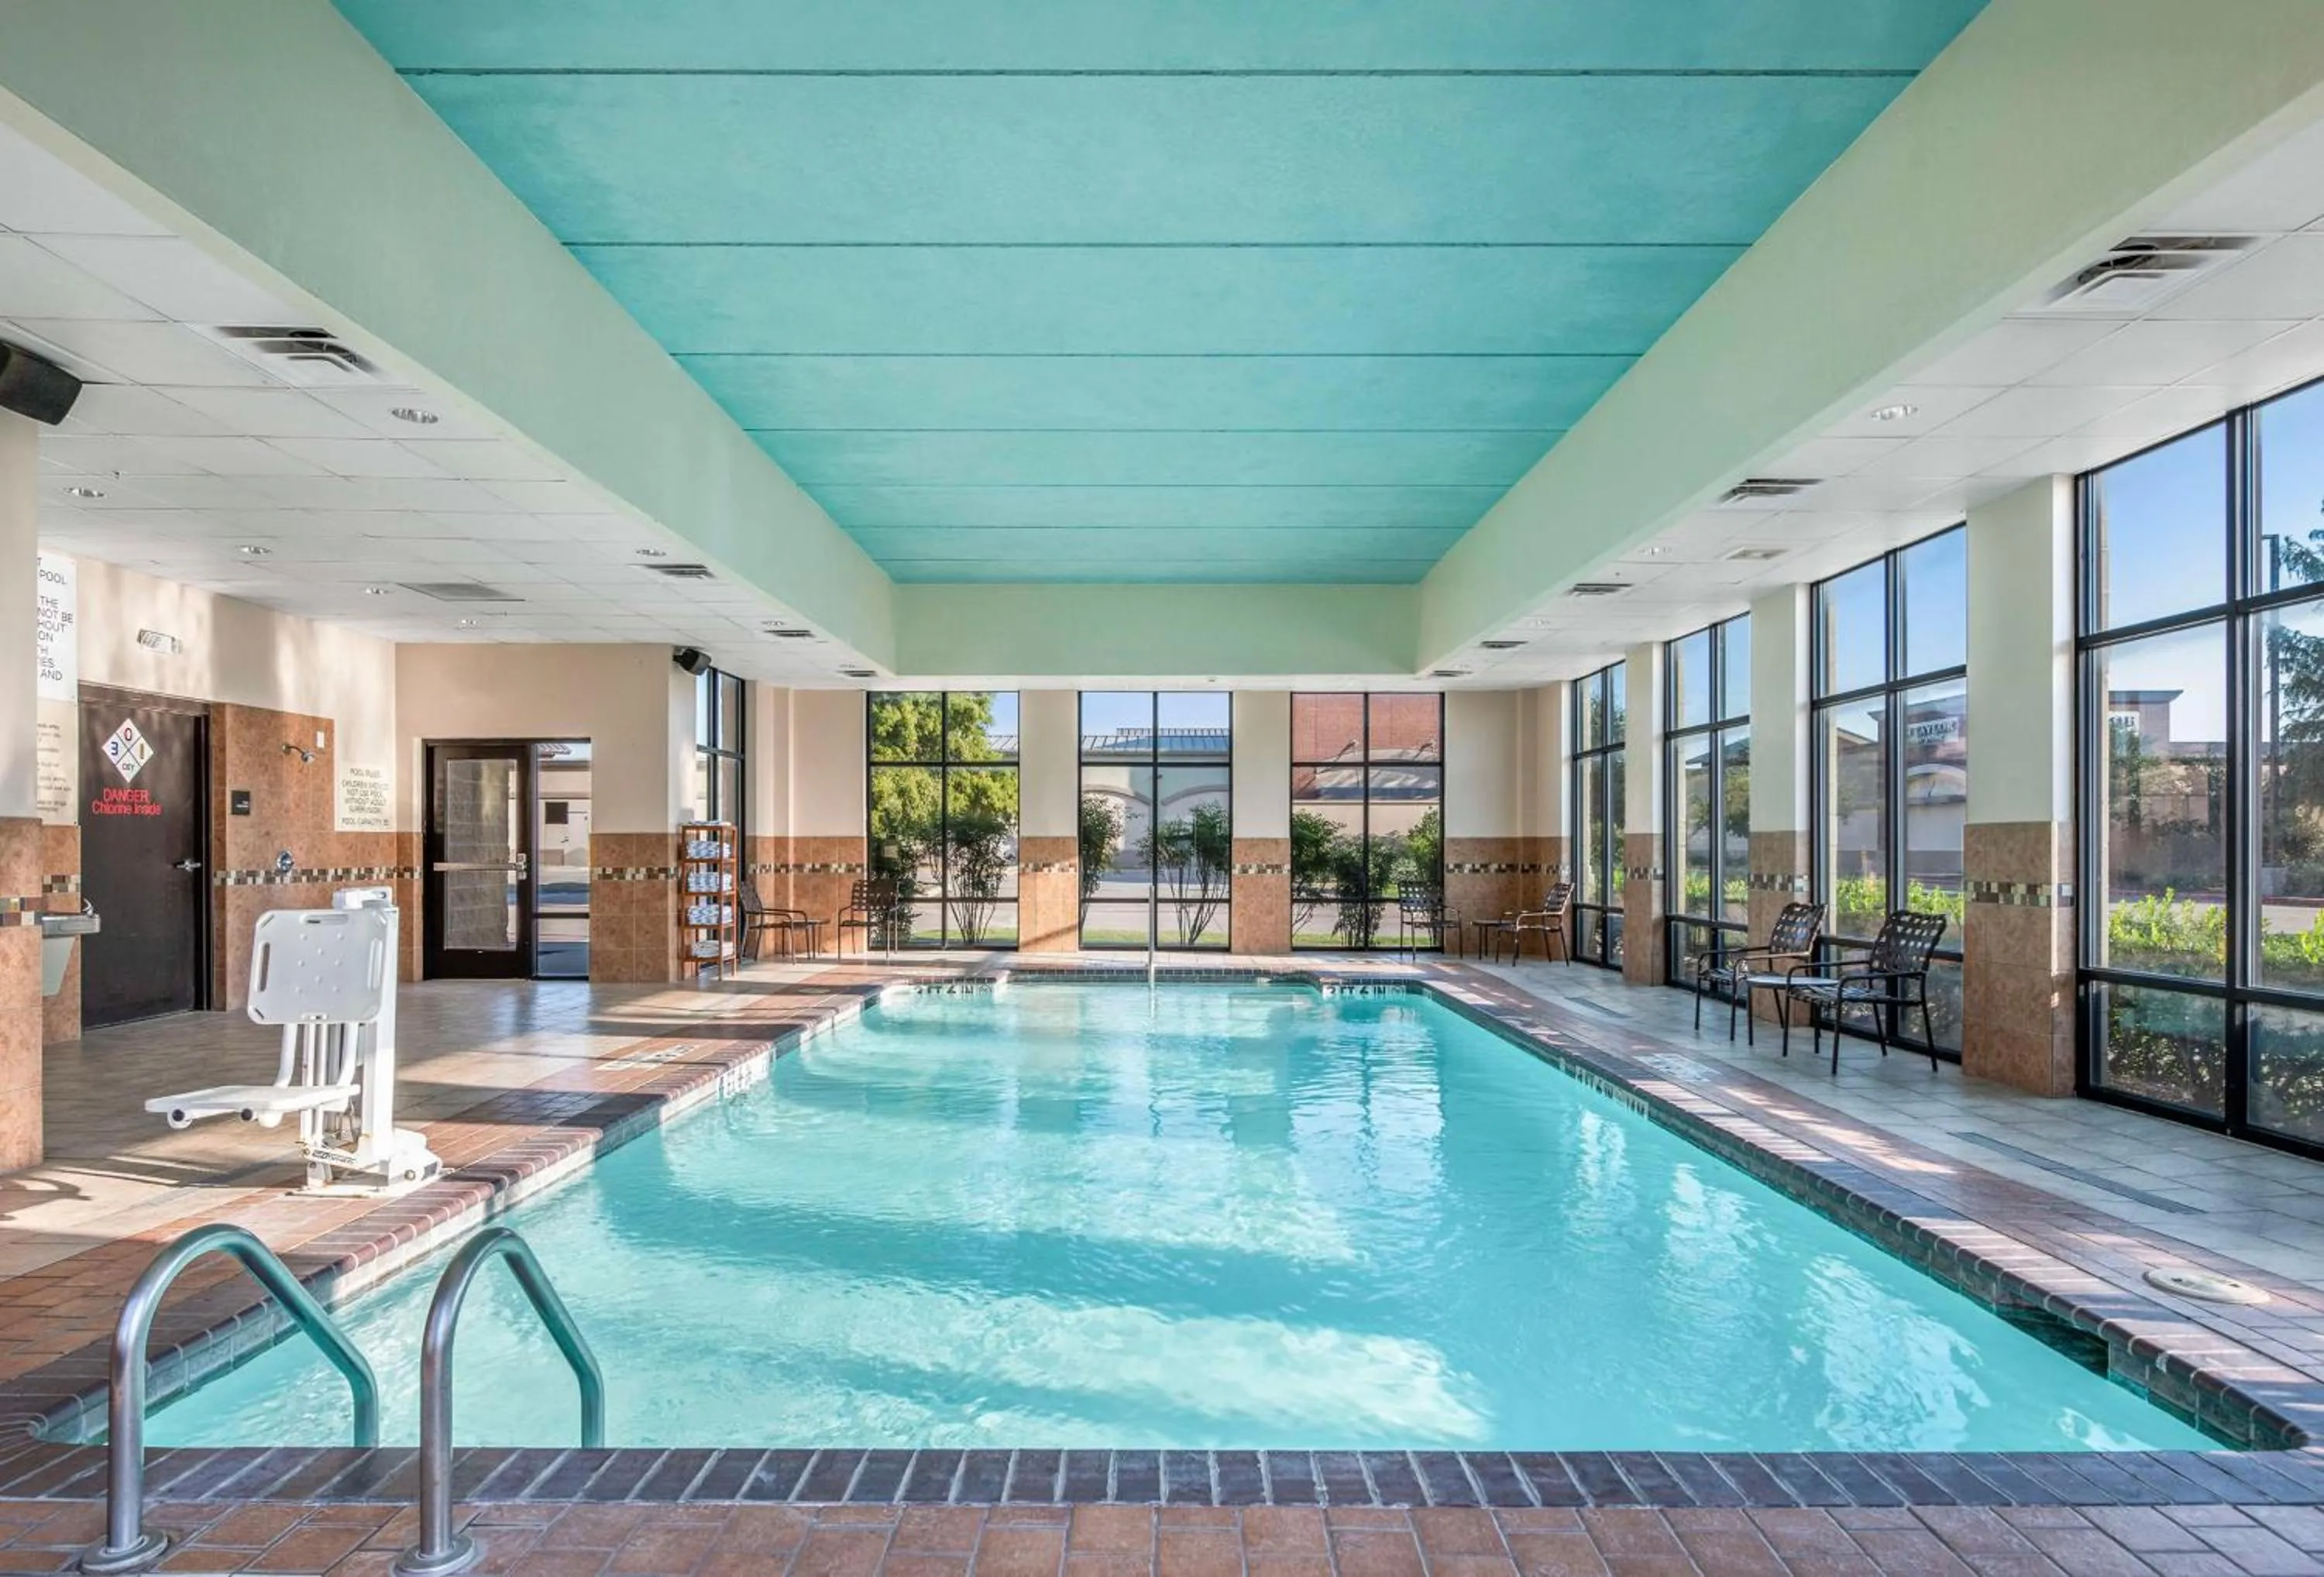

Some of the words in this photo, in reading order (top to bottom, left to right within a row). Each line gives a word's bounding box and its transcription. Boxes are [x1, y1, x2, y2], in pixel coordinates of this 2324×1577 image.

[40, 569, 68, 585] POOL
[40, 596, 59, 609] THE
[61, 611, 74, 624] BE
[40, 668, 63, 681] AND
[111, 741, 119, 756] 3
[103, 788, 150, 803] DANGER
[91, 801, 132, 816] Chlorine
[133, 802, 163, 816] Inside
